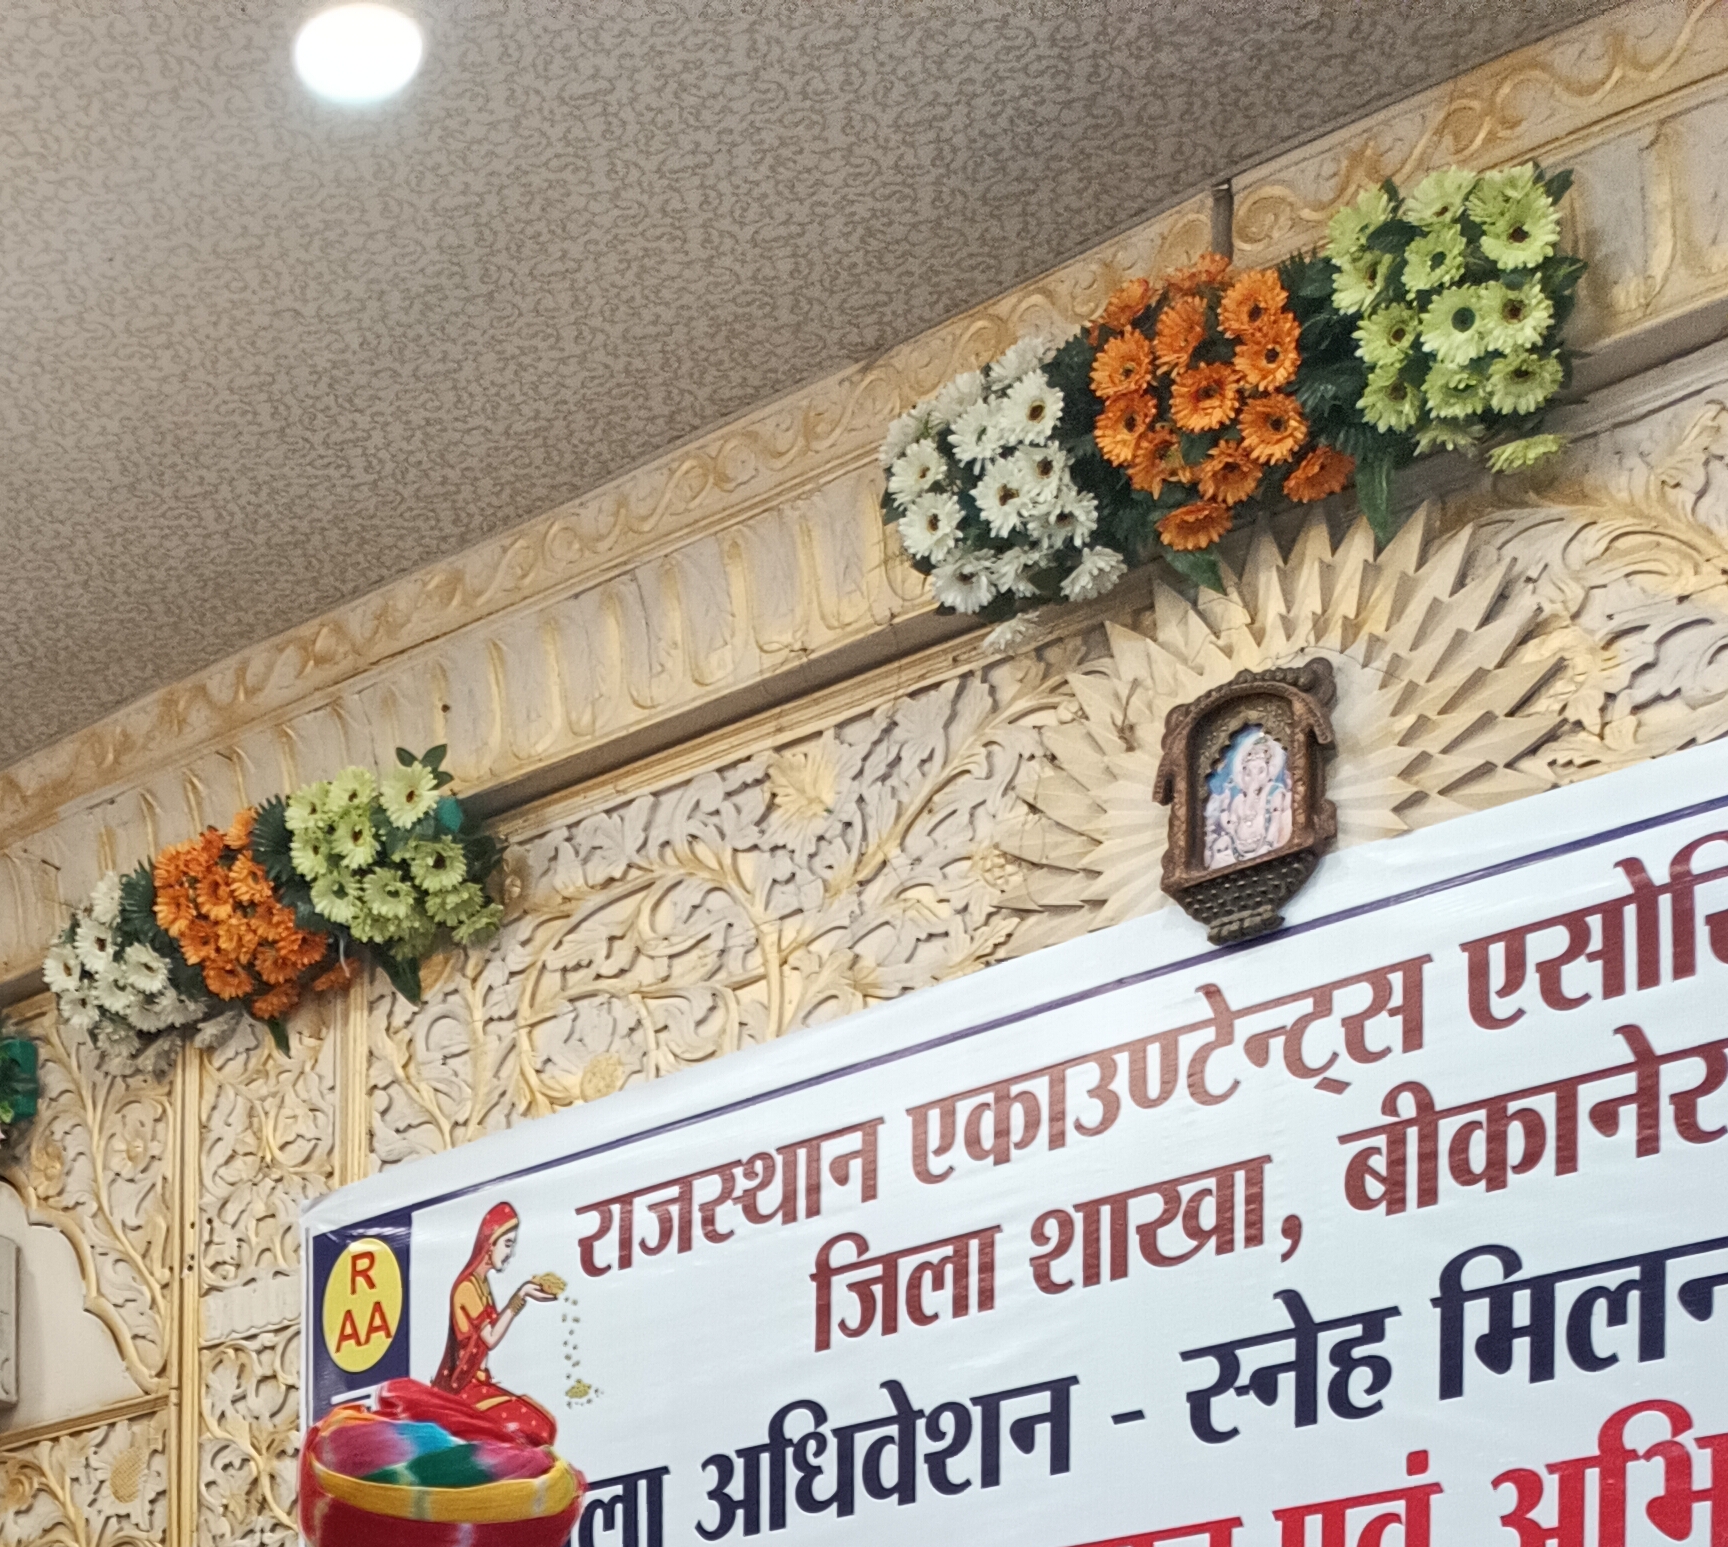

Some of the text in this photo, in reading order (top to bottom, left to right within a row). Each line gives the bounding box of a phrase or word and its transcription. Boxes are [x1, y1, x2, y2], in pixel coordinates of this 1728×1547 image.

[574, 1116, 886, 1278] राजस्थान
[904, 982, 1434, 1185] एकाउण्टेन्ट्स
[808, 1023, 1728, 1353] जिला शाखा, बीकानेर
[334, 1301, 394, 1355] AA
[349, 1250, 378, 1296] R
[693, 1374, 1080, 1542] अधिवेशन
[1179, 1288, 1402, 1445] स्नेह
